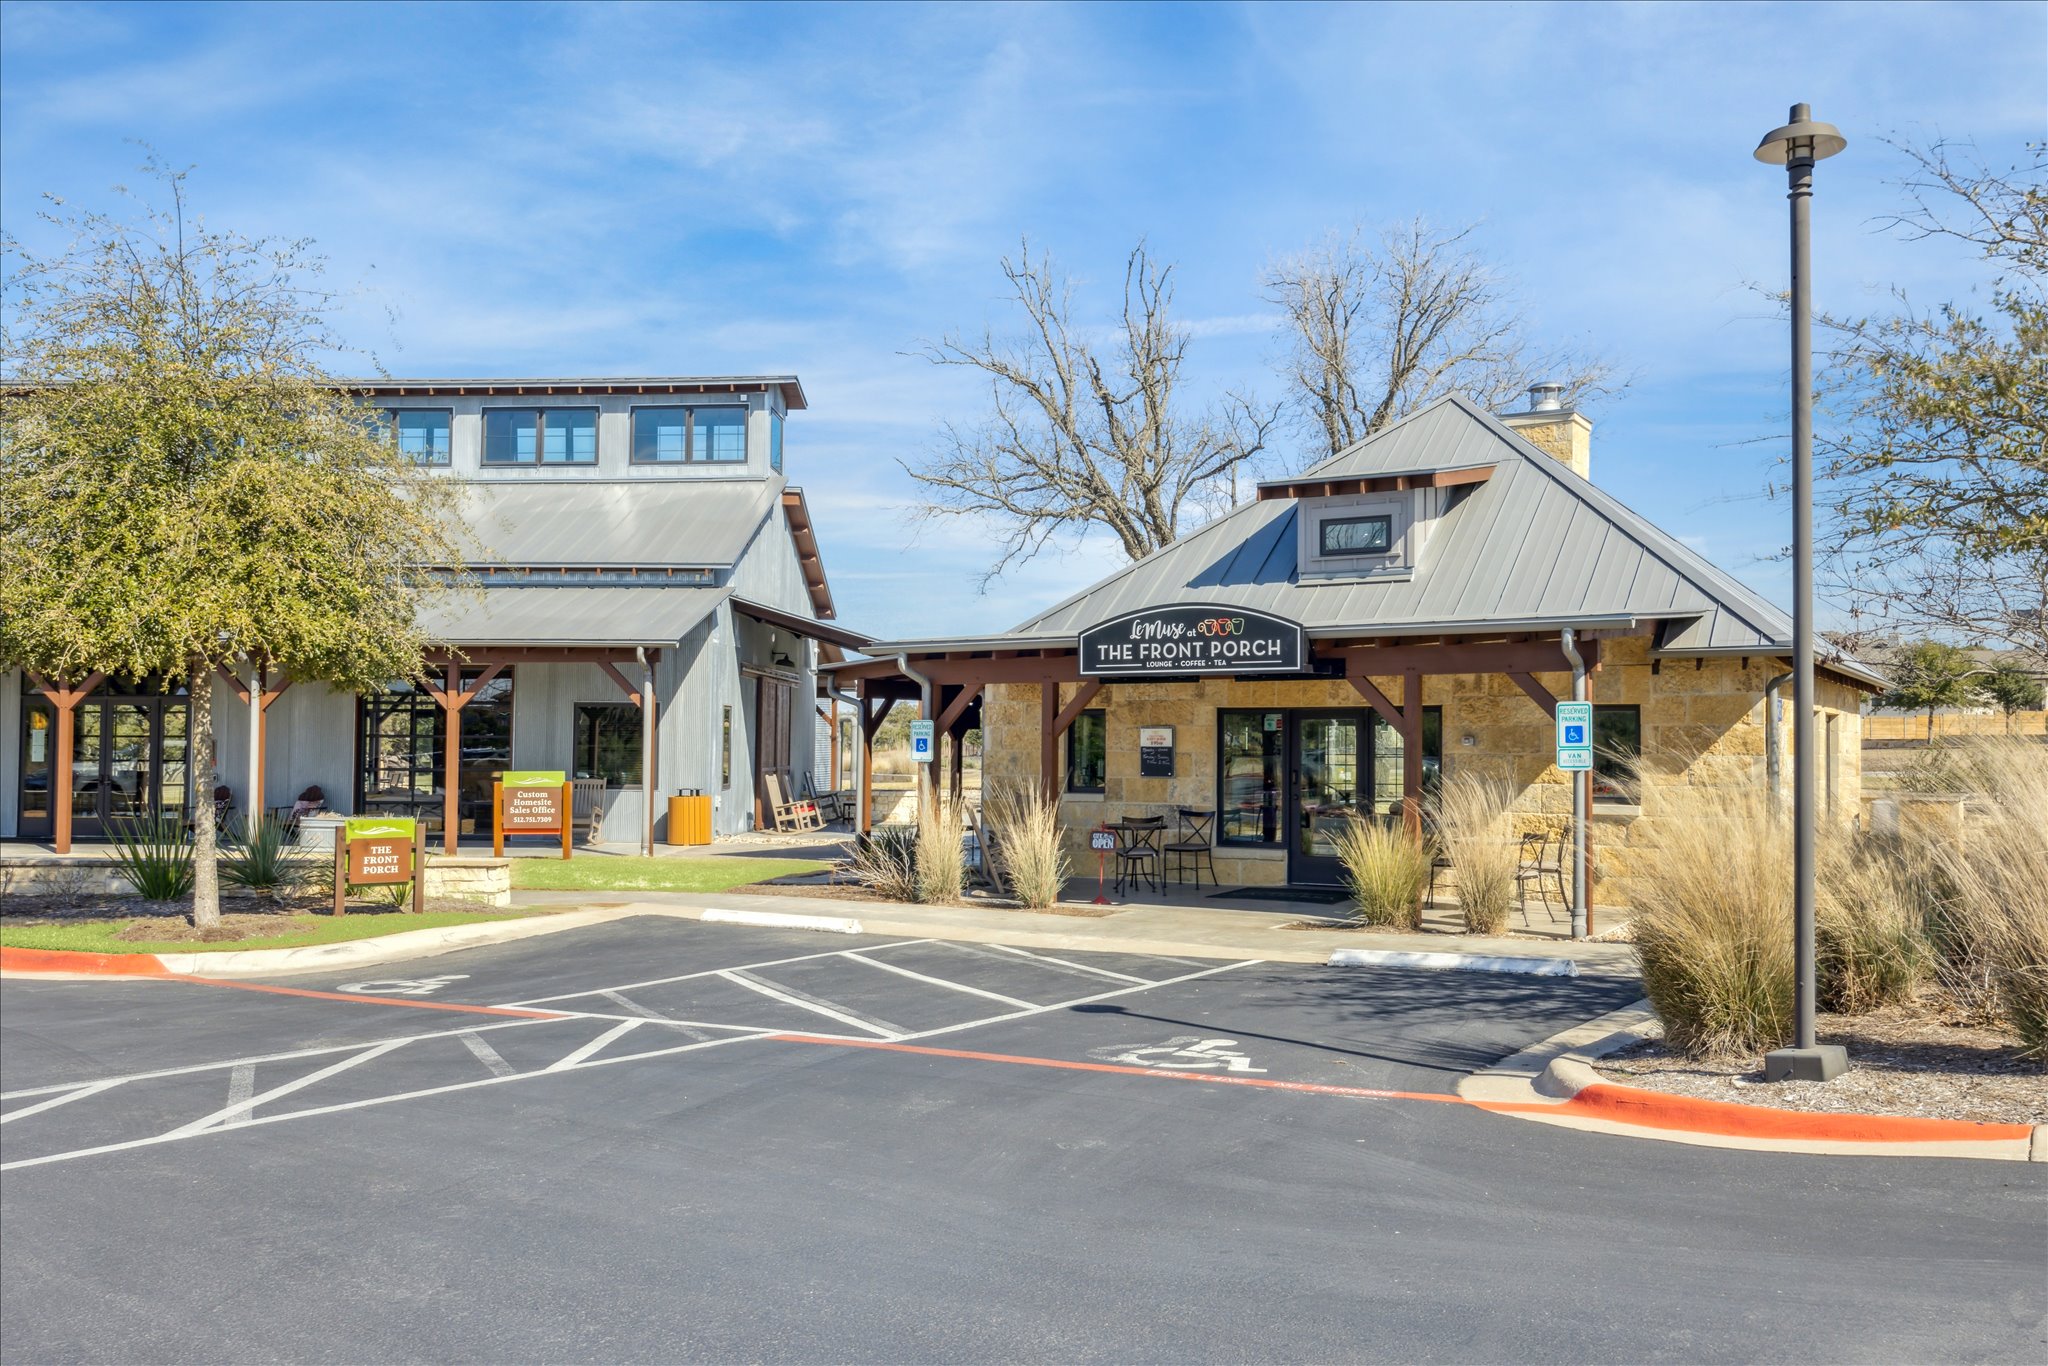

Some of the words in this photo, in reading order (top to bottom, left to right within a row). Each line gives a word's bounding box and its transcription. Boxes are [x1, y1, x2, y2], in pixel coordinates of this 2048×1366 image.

[1186, 628, 1197, 637] at
[1097, 644, 1133, 660] THE
[1140, 642, 1204, 659] FRONT
[1210, 639, 1281, 657] PORCH
[1146, 660, 1173, 668] LOUNGE
[1180, 659, 1206, 667] COFFEE
[1559, 707, 1588, 715] RESERVED
[1561, 715, 1587, 723] PARKING
[513, 798, 552, 806] Homesite
[509, 806, 531, 814] Sales
[532, 806, 556, 814] Office
[1092, 838, 1114, 849] OPEN
[370, 846, 392, 854] THE
[363, 855, 399, 865] FRONT
[363, 865, 399, 875] PORCH
